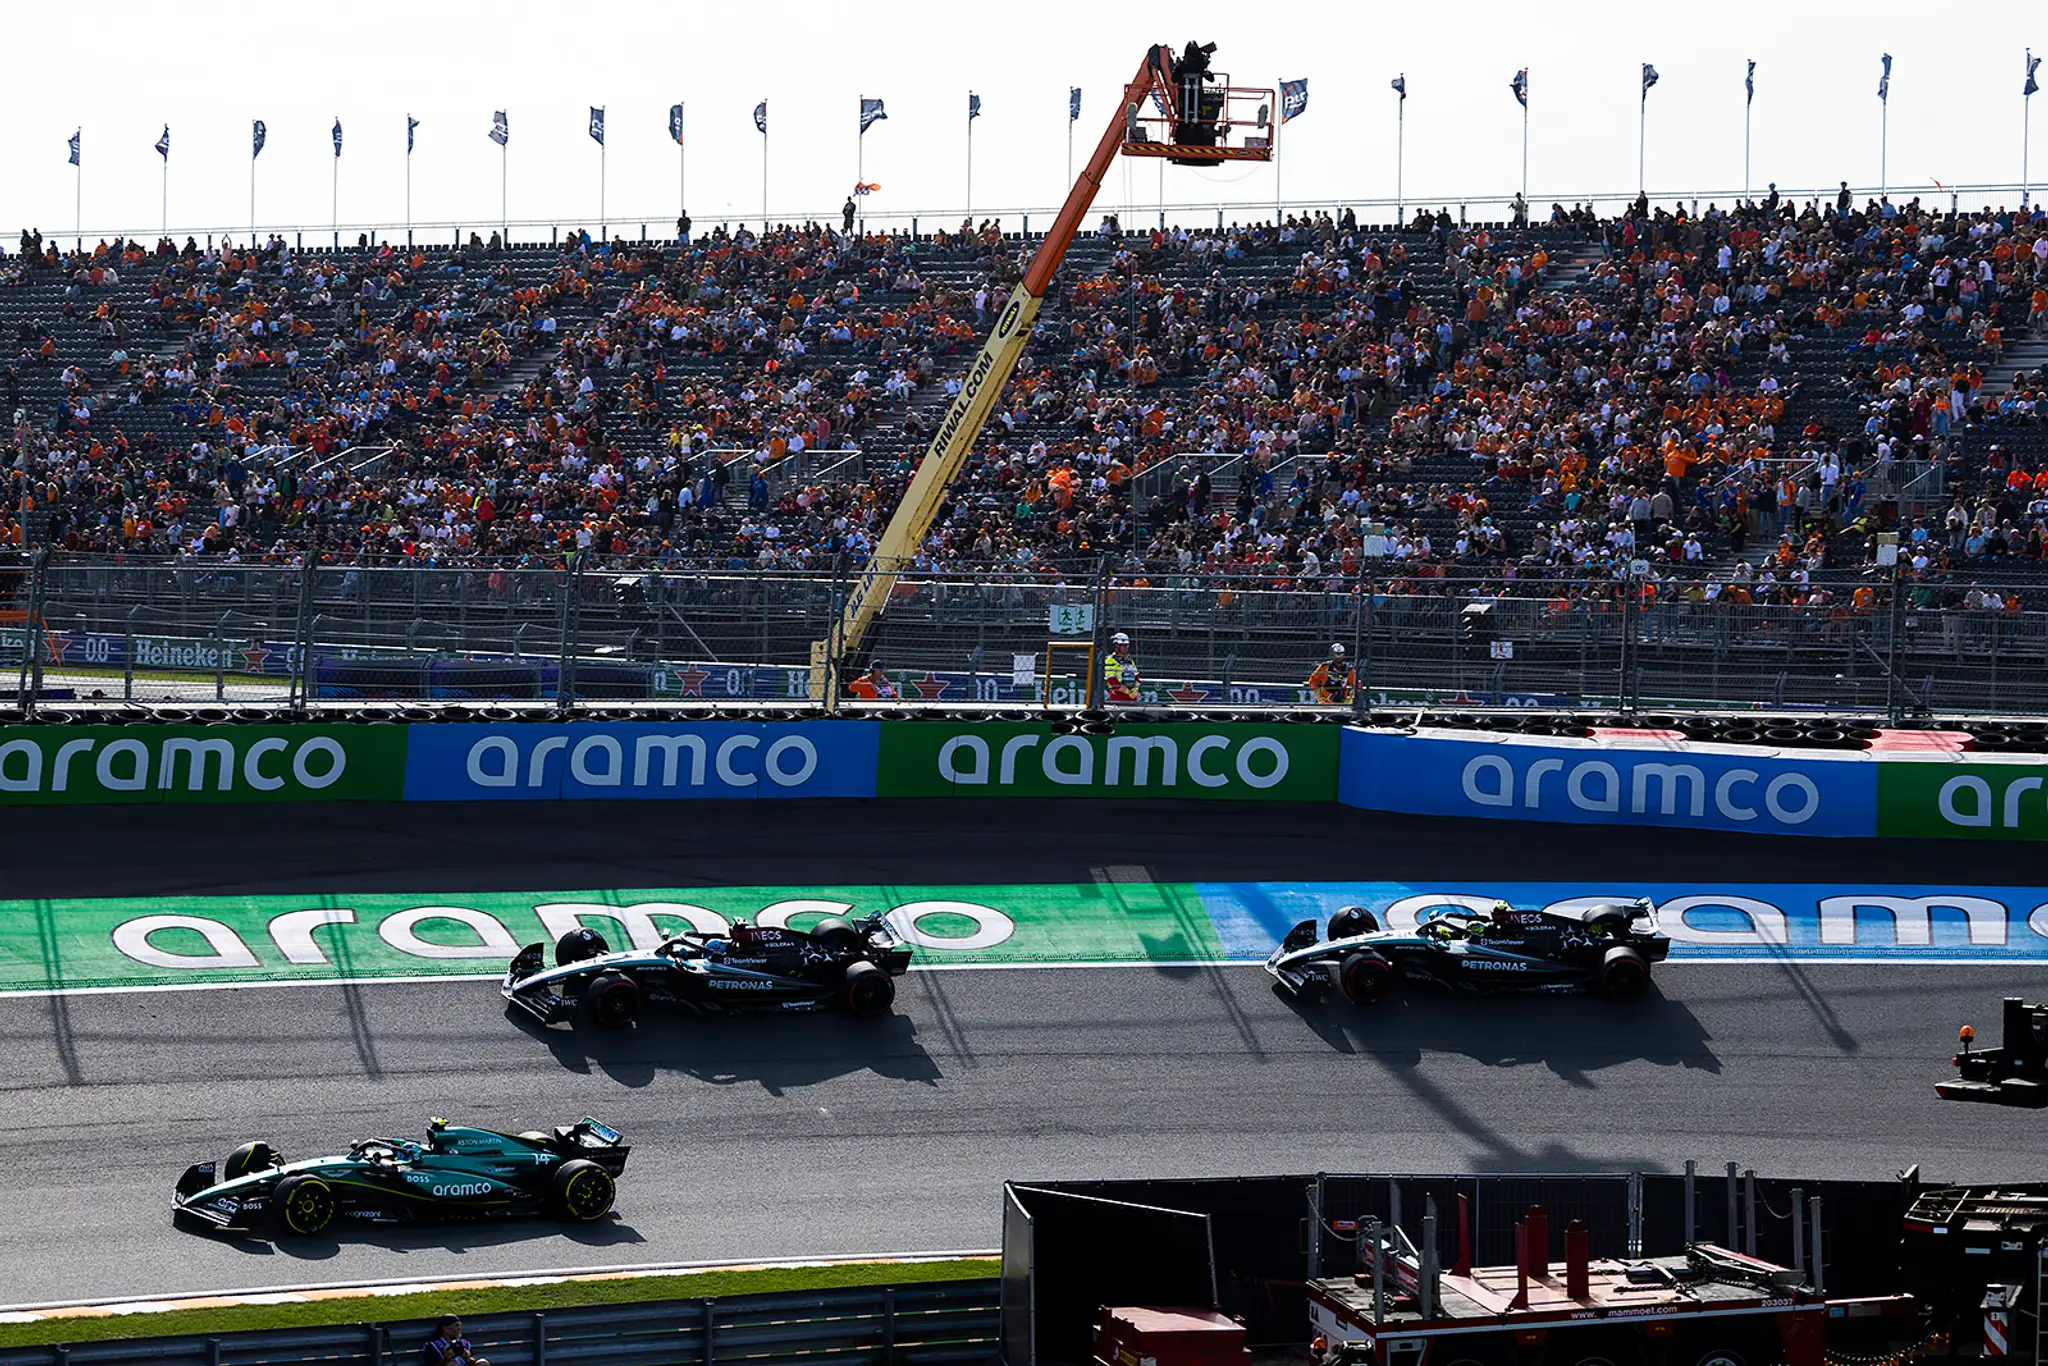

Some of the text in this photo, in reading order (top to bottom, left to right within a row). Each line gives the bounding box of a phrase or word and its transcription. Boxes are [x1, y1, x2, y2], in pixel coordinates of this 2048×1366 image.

[934, 350, 994, 458] RIWAL.COM
[135, 640, 233, 668] Heineken
[0, 737, 347, 791] aramco
[467, 734, 817, 787] aramco
[938, 734, 1289, 789] aramco
[1462, 754, 1819, 825] aramco
[1938, 775, 2048, 828] ar
[1510, 914, 1543, 924] INEOS
[751, 931, 782, 941] INEOS
[730, 956, 768, 964] TeamViewer
[1462, 960, 1527, 971] PETRONAS
[709, 979, 773, 991] PETRONAS
[532, 1153, 550, 1165] 14
[433, 1182, 492, 1196] aramco
[1761, 1298, 1793, 1307] 203037
